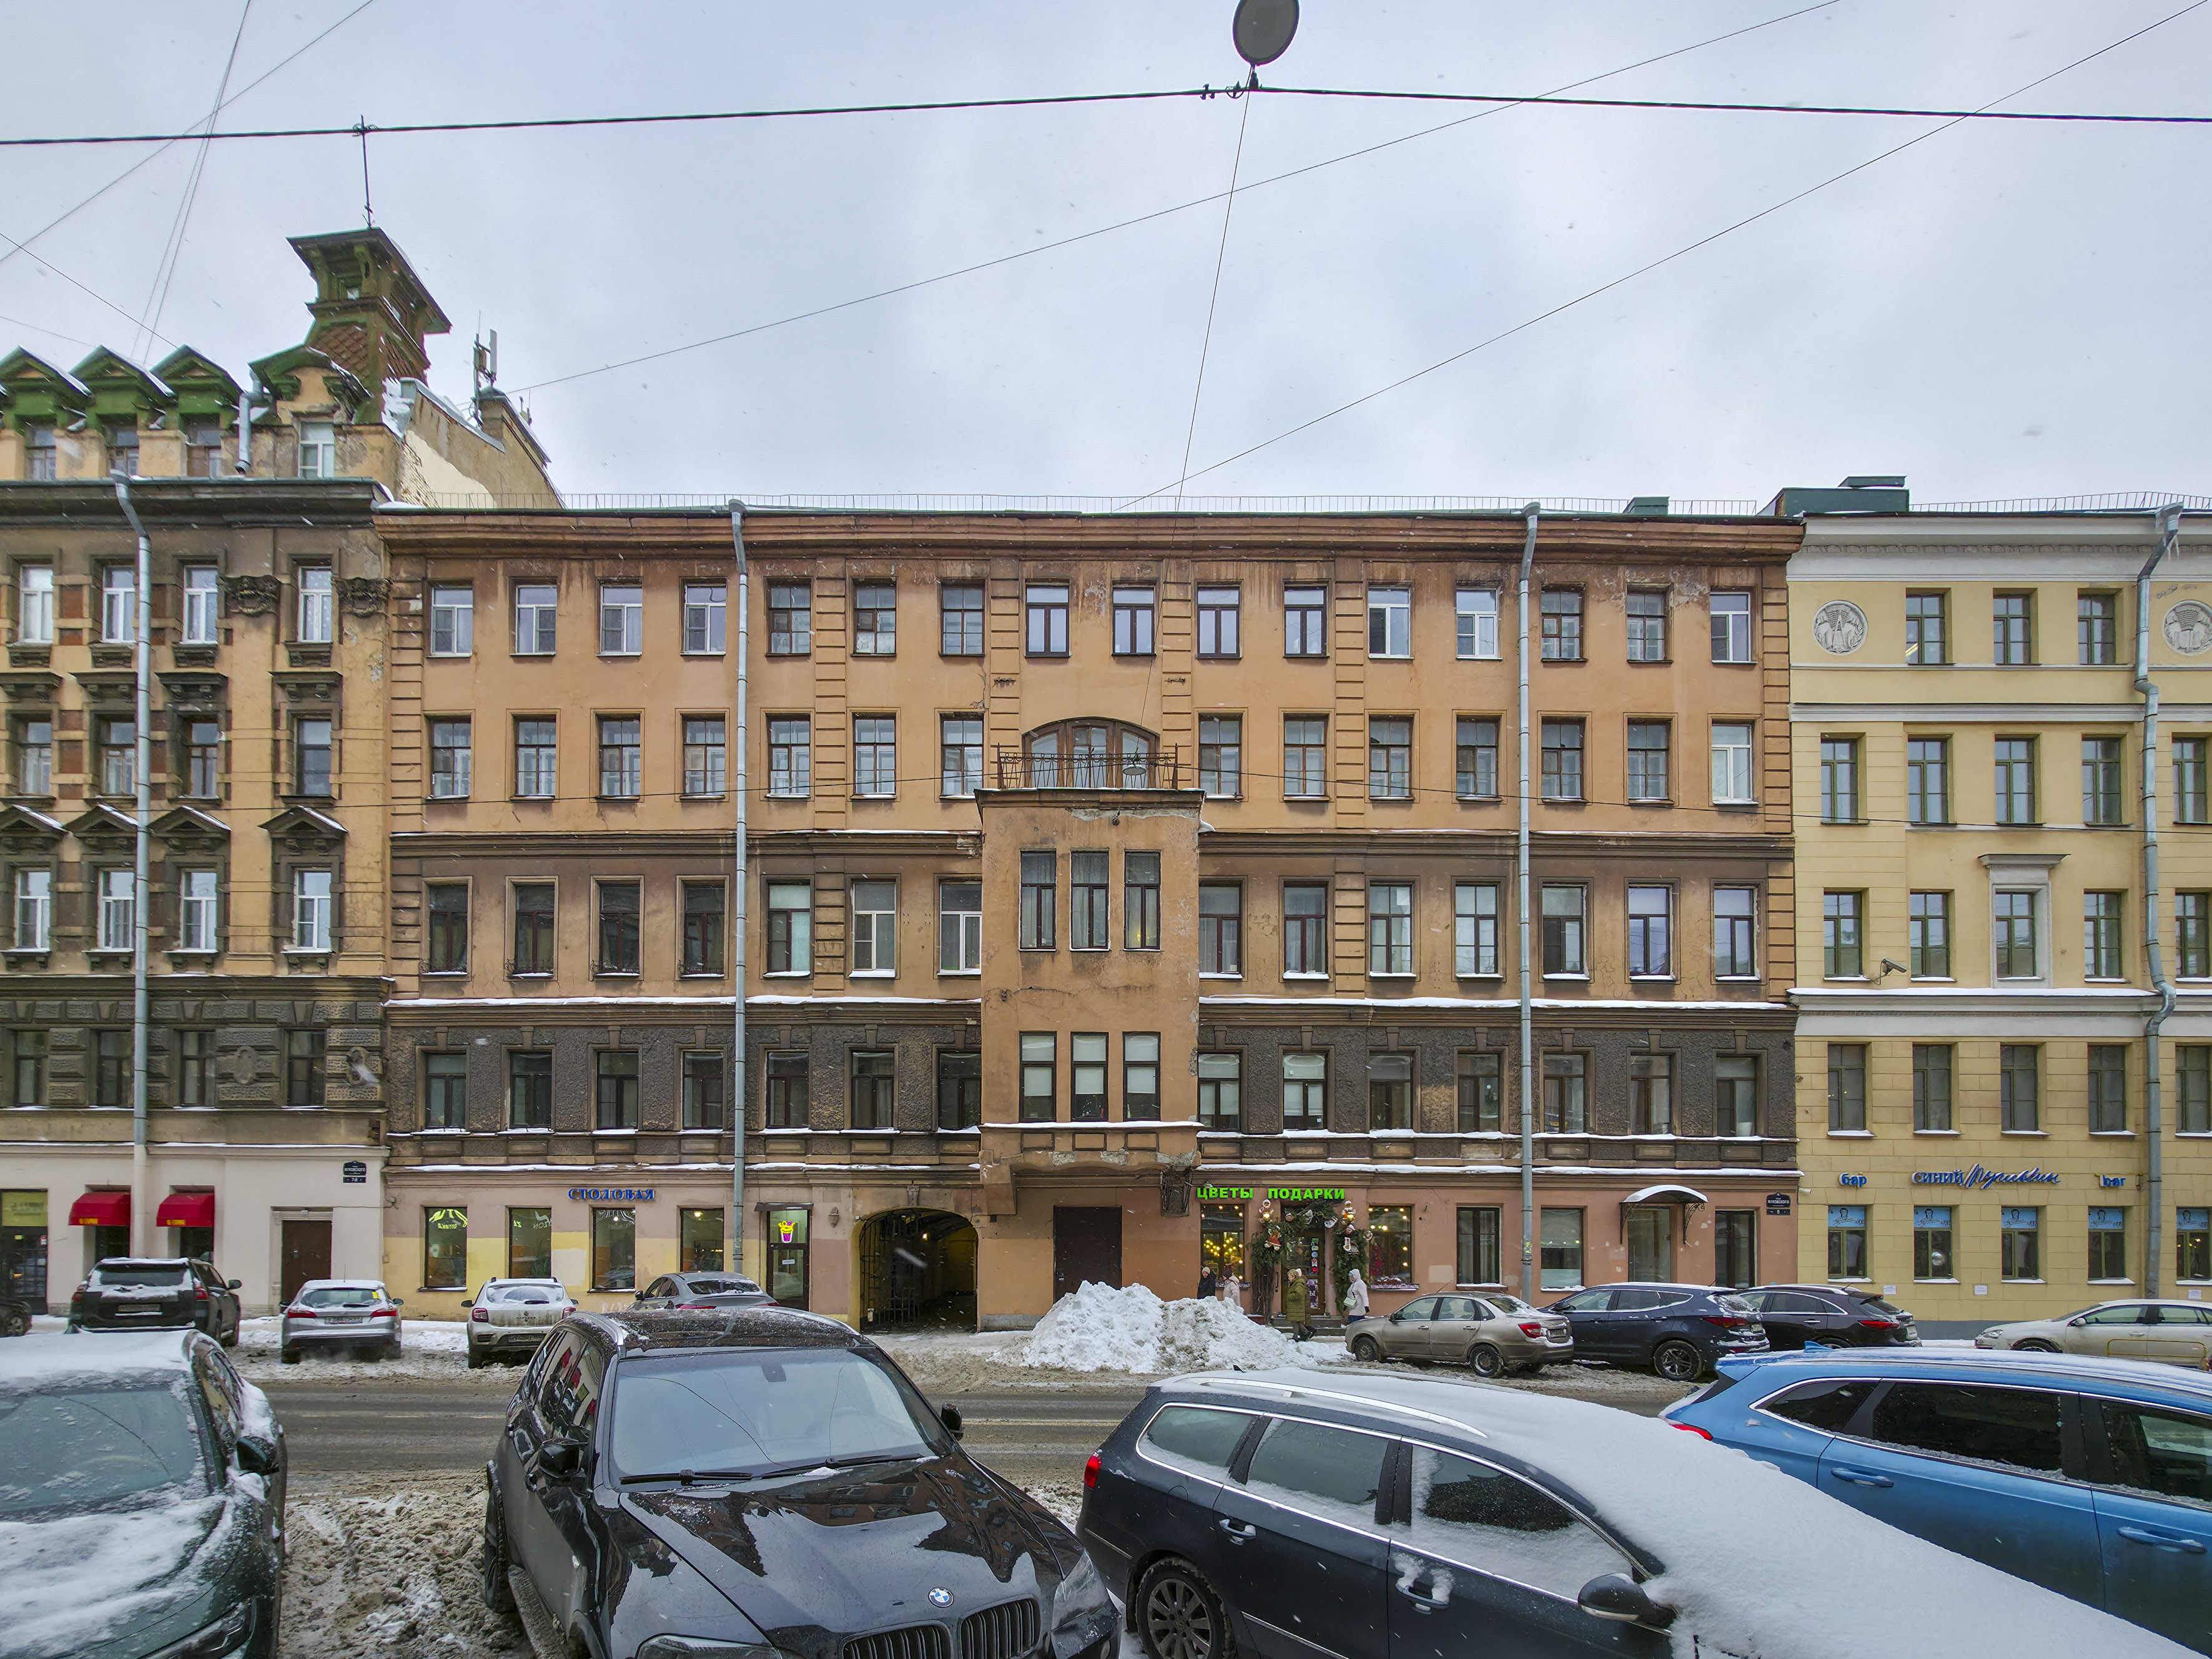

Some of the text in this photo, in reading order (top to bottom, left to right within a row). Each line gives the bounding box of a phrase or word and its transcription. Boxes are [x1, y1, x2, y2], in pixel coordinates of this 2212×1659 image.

[1840, 1173, 1867, 1188] бар
[2100, 1174, 2126, 1186] bar
[568, 1188, 655, 1200] СТОЛОВАЯ
[1197, 1187, 1345, 1201] ЦВЕТЫ ПОДАРКИ
